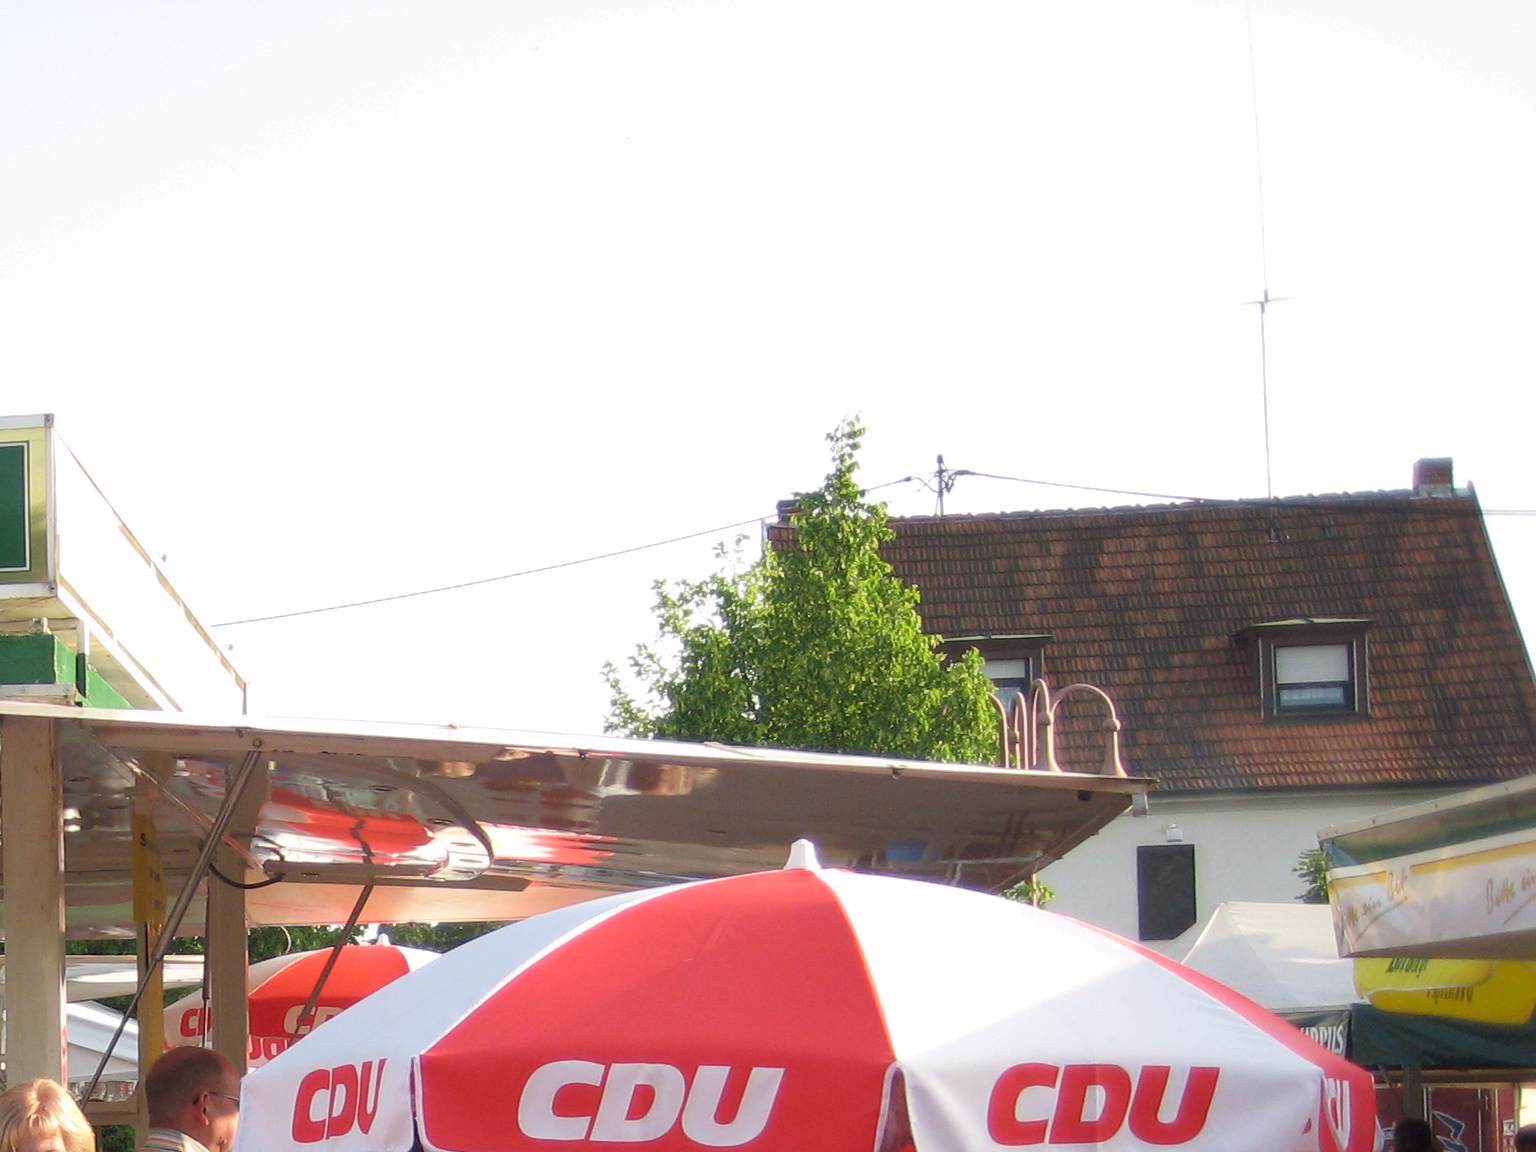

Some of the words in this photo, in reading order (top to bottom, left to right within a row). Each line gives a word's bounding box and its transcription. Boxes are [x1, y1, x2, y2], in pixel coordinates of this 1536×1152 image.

[292, 1058, 388, 1143] CDU
[517, 1060, 785, 1147] CDU
[987, 1062, 1220, 1146] CDU
